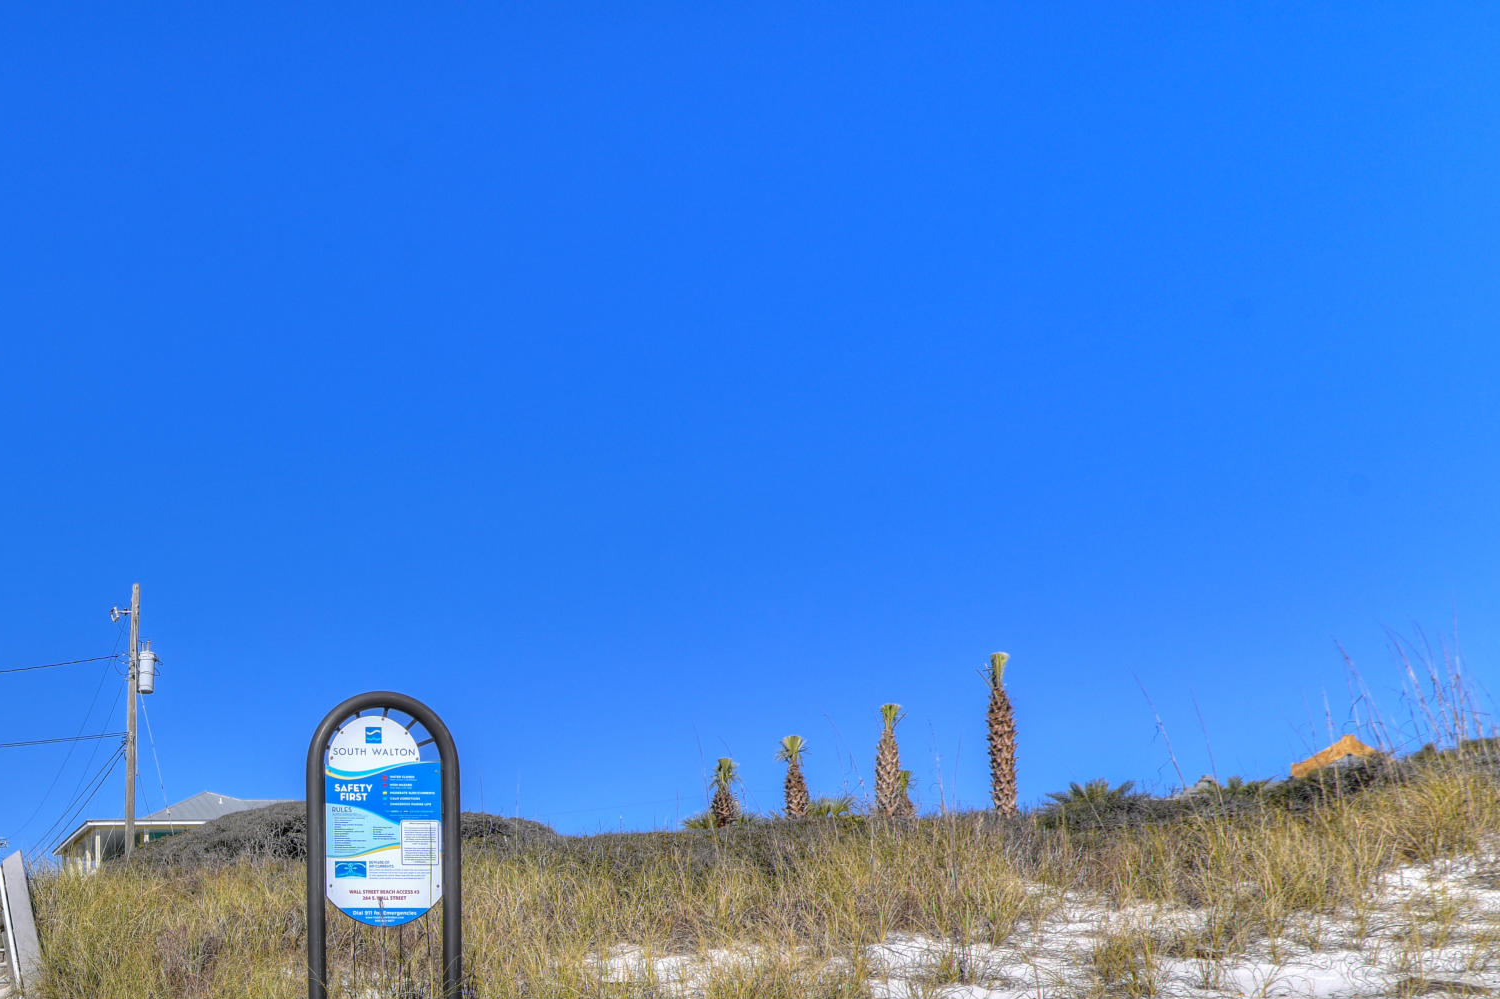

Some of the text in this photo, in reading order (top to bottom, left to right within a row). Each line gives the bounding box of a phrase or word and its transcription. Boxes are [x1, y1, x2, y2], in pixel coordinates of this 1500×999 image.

[333, 748, 415, 756] SOUTH WALTON
[334, 784, 372, 792] SAFETY
[340, 793, 368, 801] FIRST
